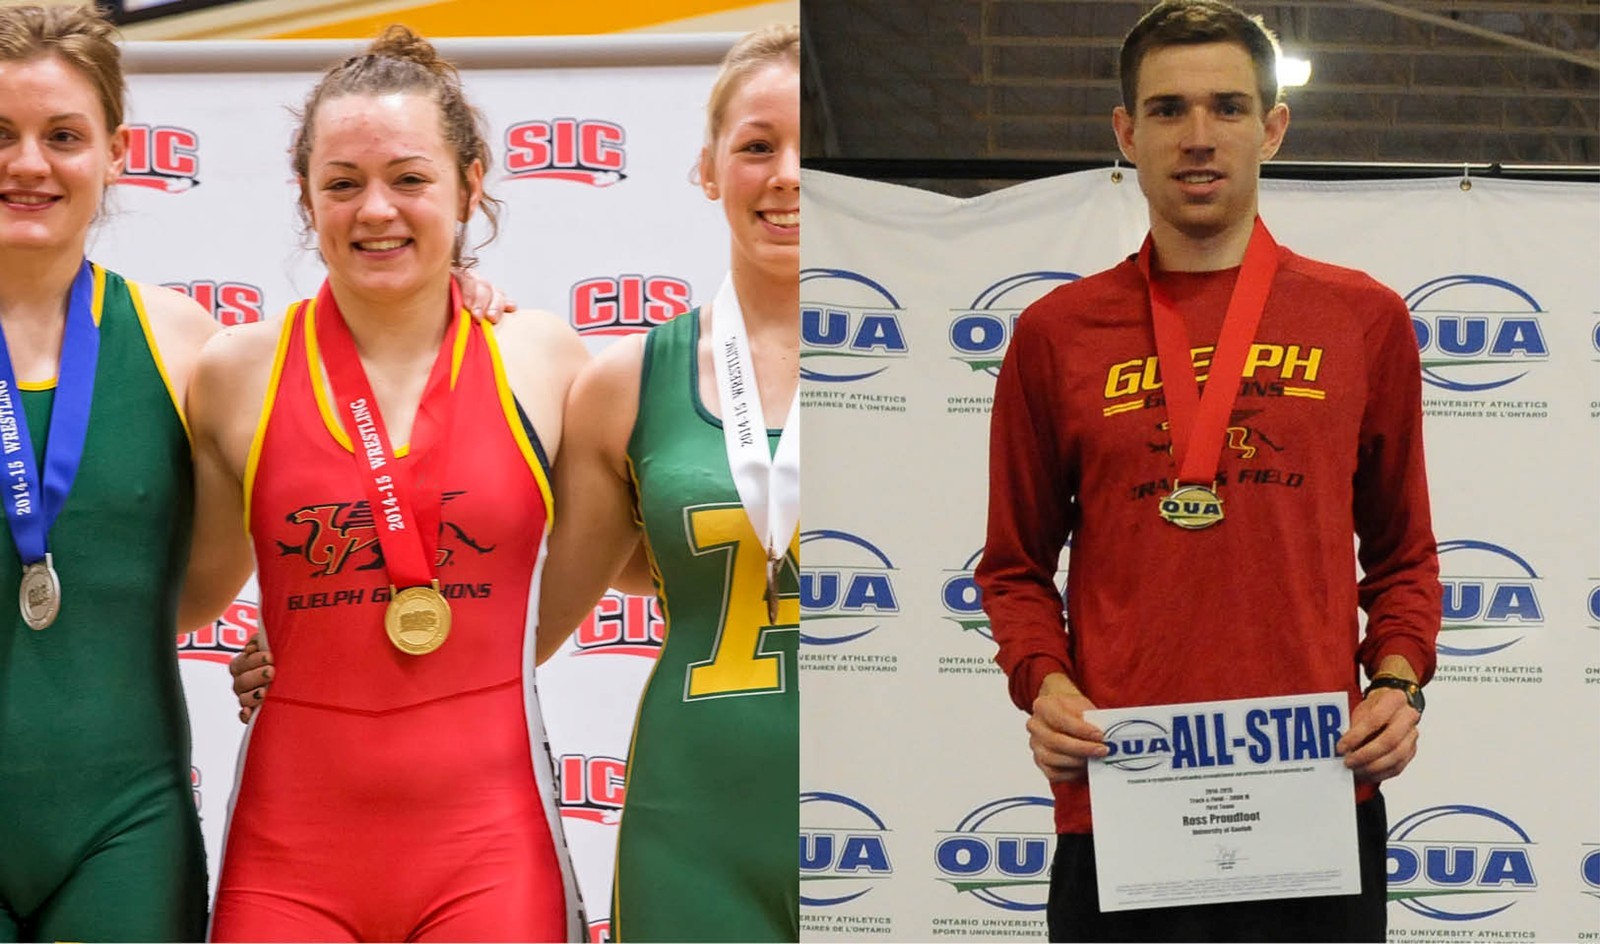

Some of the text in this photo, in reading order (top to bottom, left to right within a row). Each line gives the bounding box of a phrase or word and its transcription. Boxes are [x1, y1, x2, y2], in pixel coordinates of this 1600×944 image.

[125, 125, 199, 176] IC
[505, 118, 626, 172] SIC
[168, 281, 263, 326] IS
[570, 275, 693, 330] CIS
[800, 308, 909, 353] UA
[850, 393, 906, 403] ATHLETICS
[1422, 400, 1485, 408] UNIVERSITY
[350, 398, 405, 531] WRESTLING 2014-15
[1239, 470, 1304, 488] FIELD
[7, 461, 32, 516] 2014-15
[1161, 499, 1222, 517] OUA
[288, 590, 365, 611] GUELPH
[800, 571, 900, 612] UA
[1442, 582, 1544, 622] UA
[177, 600, 259, 651] IS
[800, 653, 898, 663] VERSITY ATHLETICS
[938, 656, 985, 665] ONTARIO
[1437, 665, 1543, 674] VERSITY ATHLETICS
[1171, 704, 1345, 769] ALL-STAR
[556, 754, 627, 807] IC
[1182, 816, 1208, 826] Ross
[800, 833, 893, 874] UA
[934, 836, 1056, 878] OU
[836, 916, 891, 925] ATHLETICS
[932, 918, 1045, 928] ONTARIO UNIVERSITY
[932, 928, 967, 936] SPORTS
[1410, 929, 1474, 938] UNIVERSITY
[1478, 930, 1536, 939] ATHLETICS
